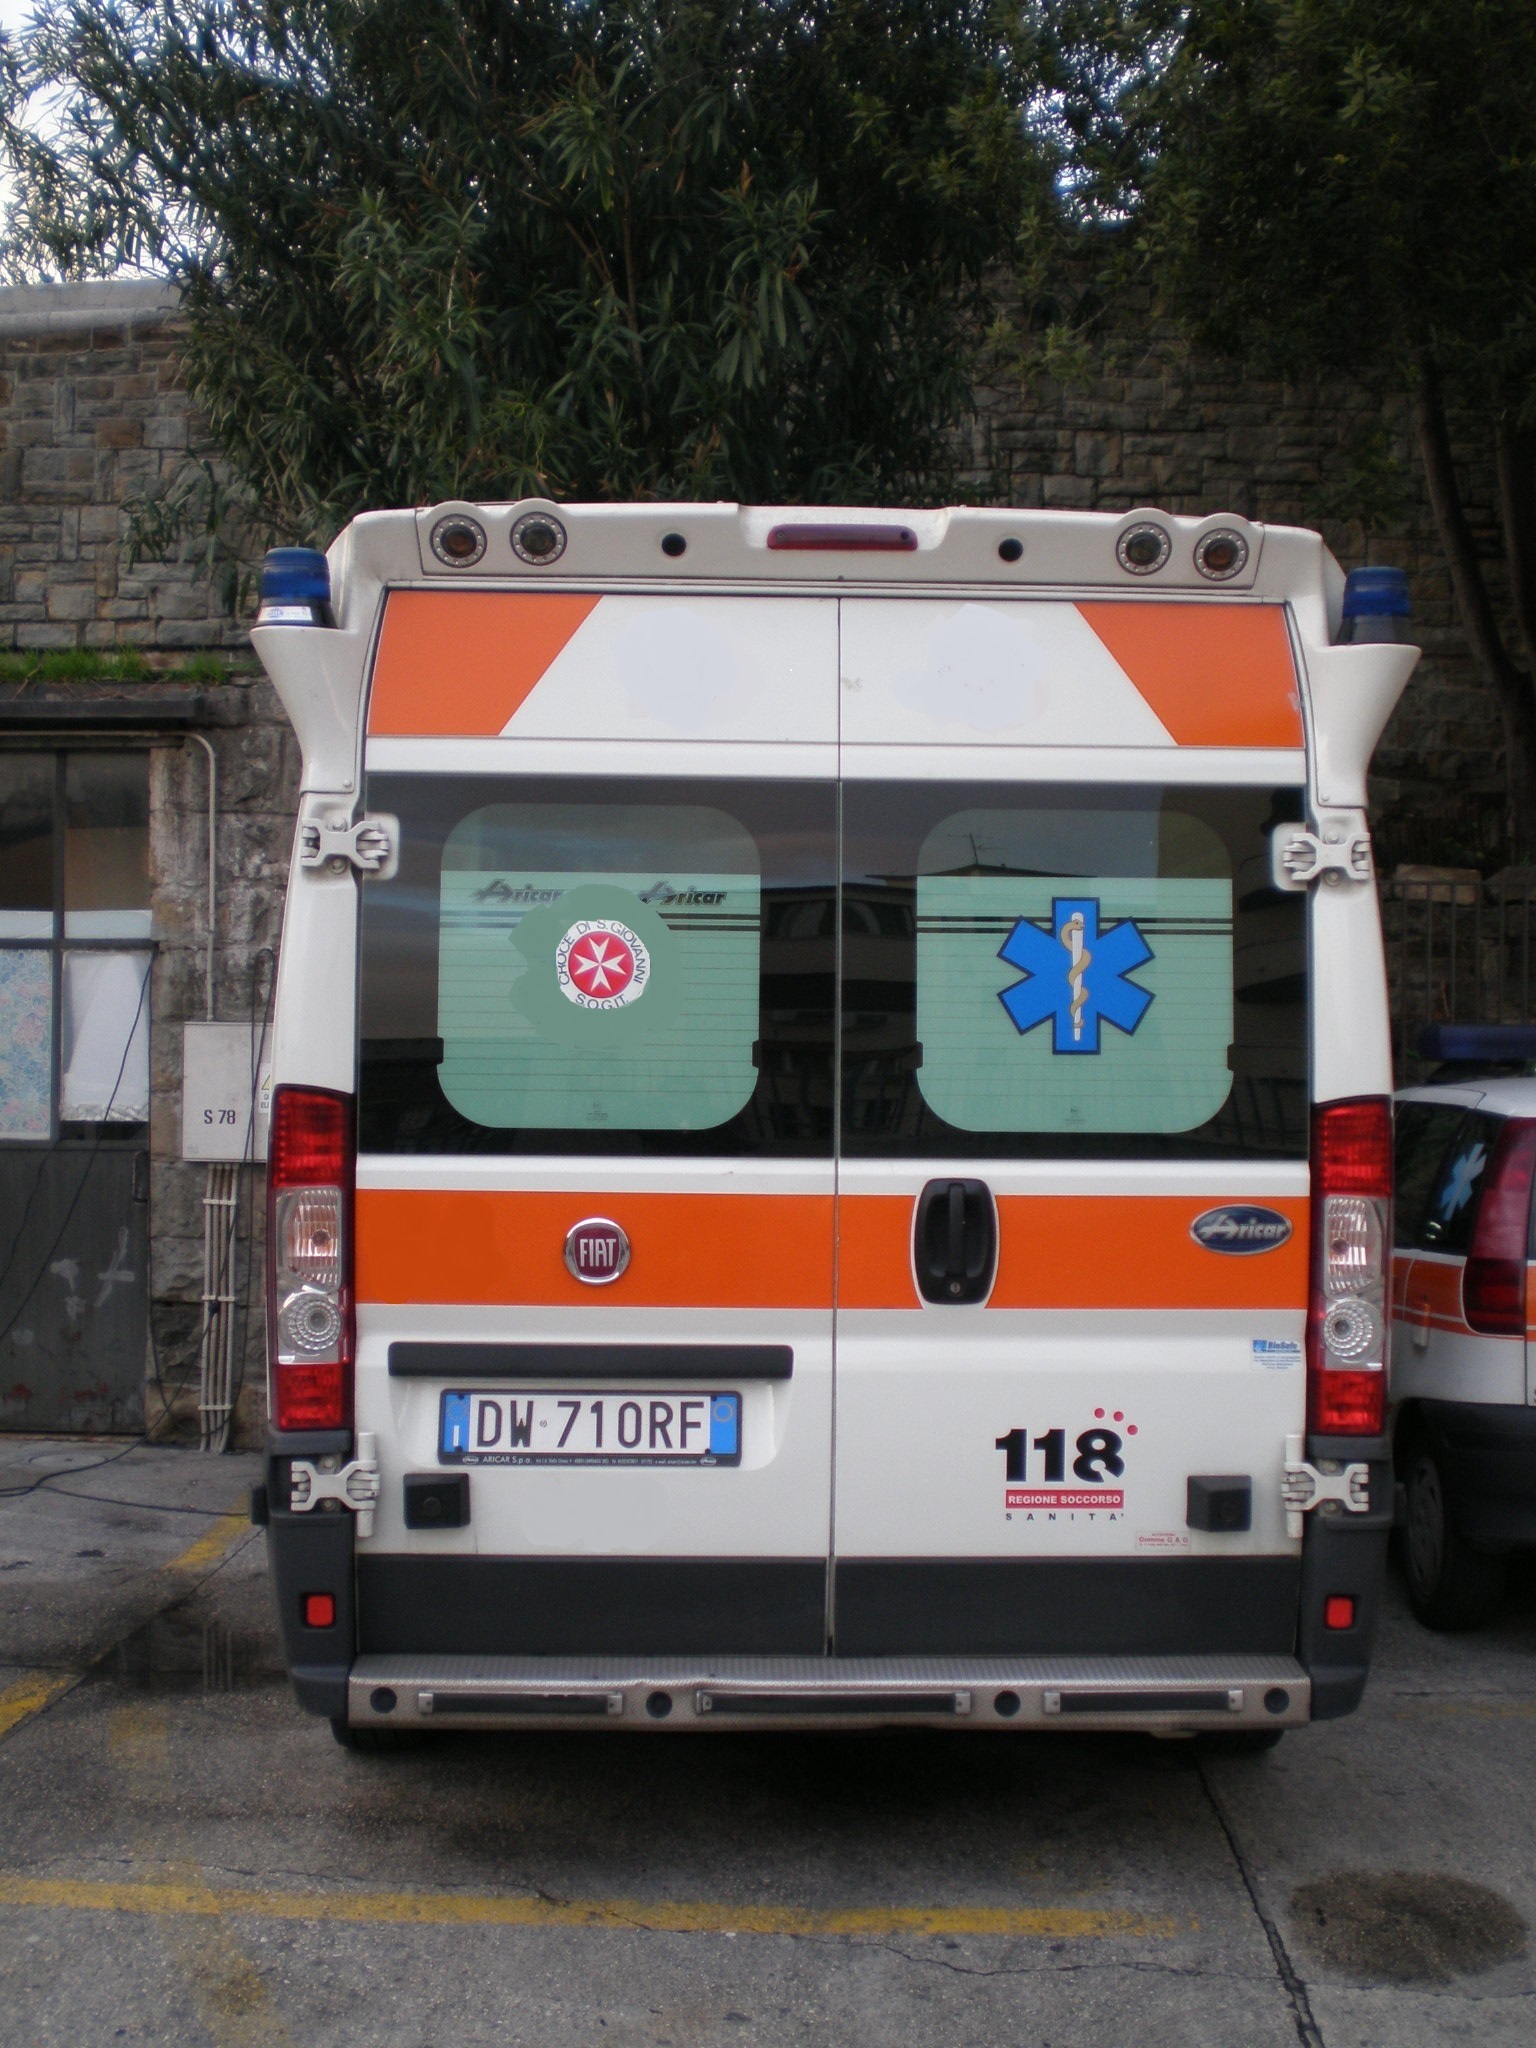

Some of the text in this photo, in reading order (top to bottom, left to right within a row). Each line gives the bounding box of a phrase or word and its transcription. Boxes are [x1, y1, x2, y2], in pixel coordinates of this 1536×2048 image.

[576, 921, 592, 935] DI
[204, 1110, 236, 1125] S 78
[1199, 1214, 1287, 1240] Aricar
[579, 1238, 617, 1267] FIAT
[476, 1399, 705, 1450] DW 710RF
[482, 1455, 511, 1464] ARICAR
[995, 1428, 1125, 1483] 118
[1007, 1494, 1121, 1504] REGIONE SOCCORSO
